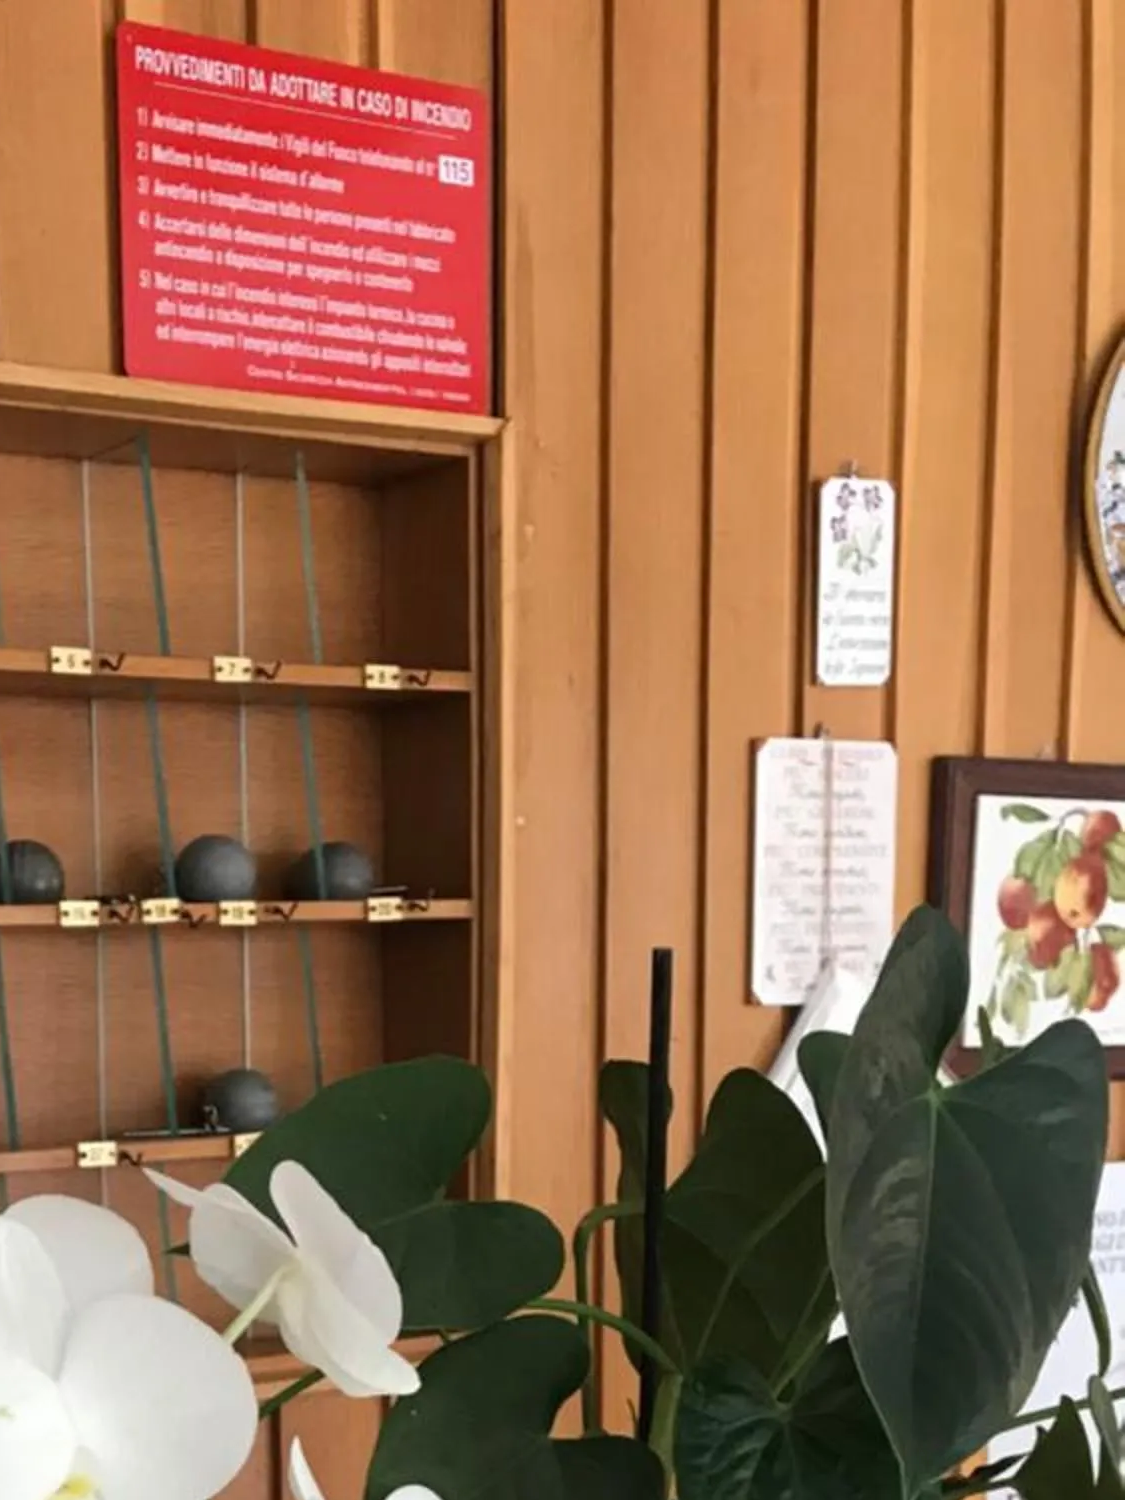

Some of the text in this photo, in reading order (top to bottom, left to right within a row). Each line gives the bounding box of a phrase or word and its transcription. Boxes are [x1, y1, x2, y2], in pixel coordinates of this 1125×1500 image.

[135, 45, 471, 131] PROVVEDIMENTI DA ADOTTARE IN CASO DI INCENDIO
[442, 159, 470, 183] 115
[229, 662, 236, 676] 7
